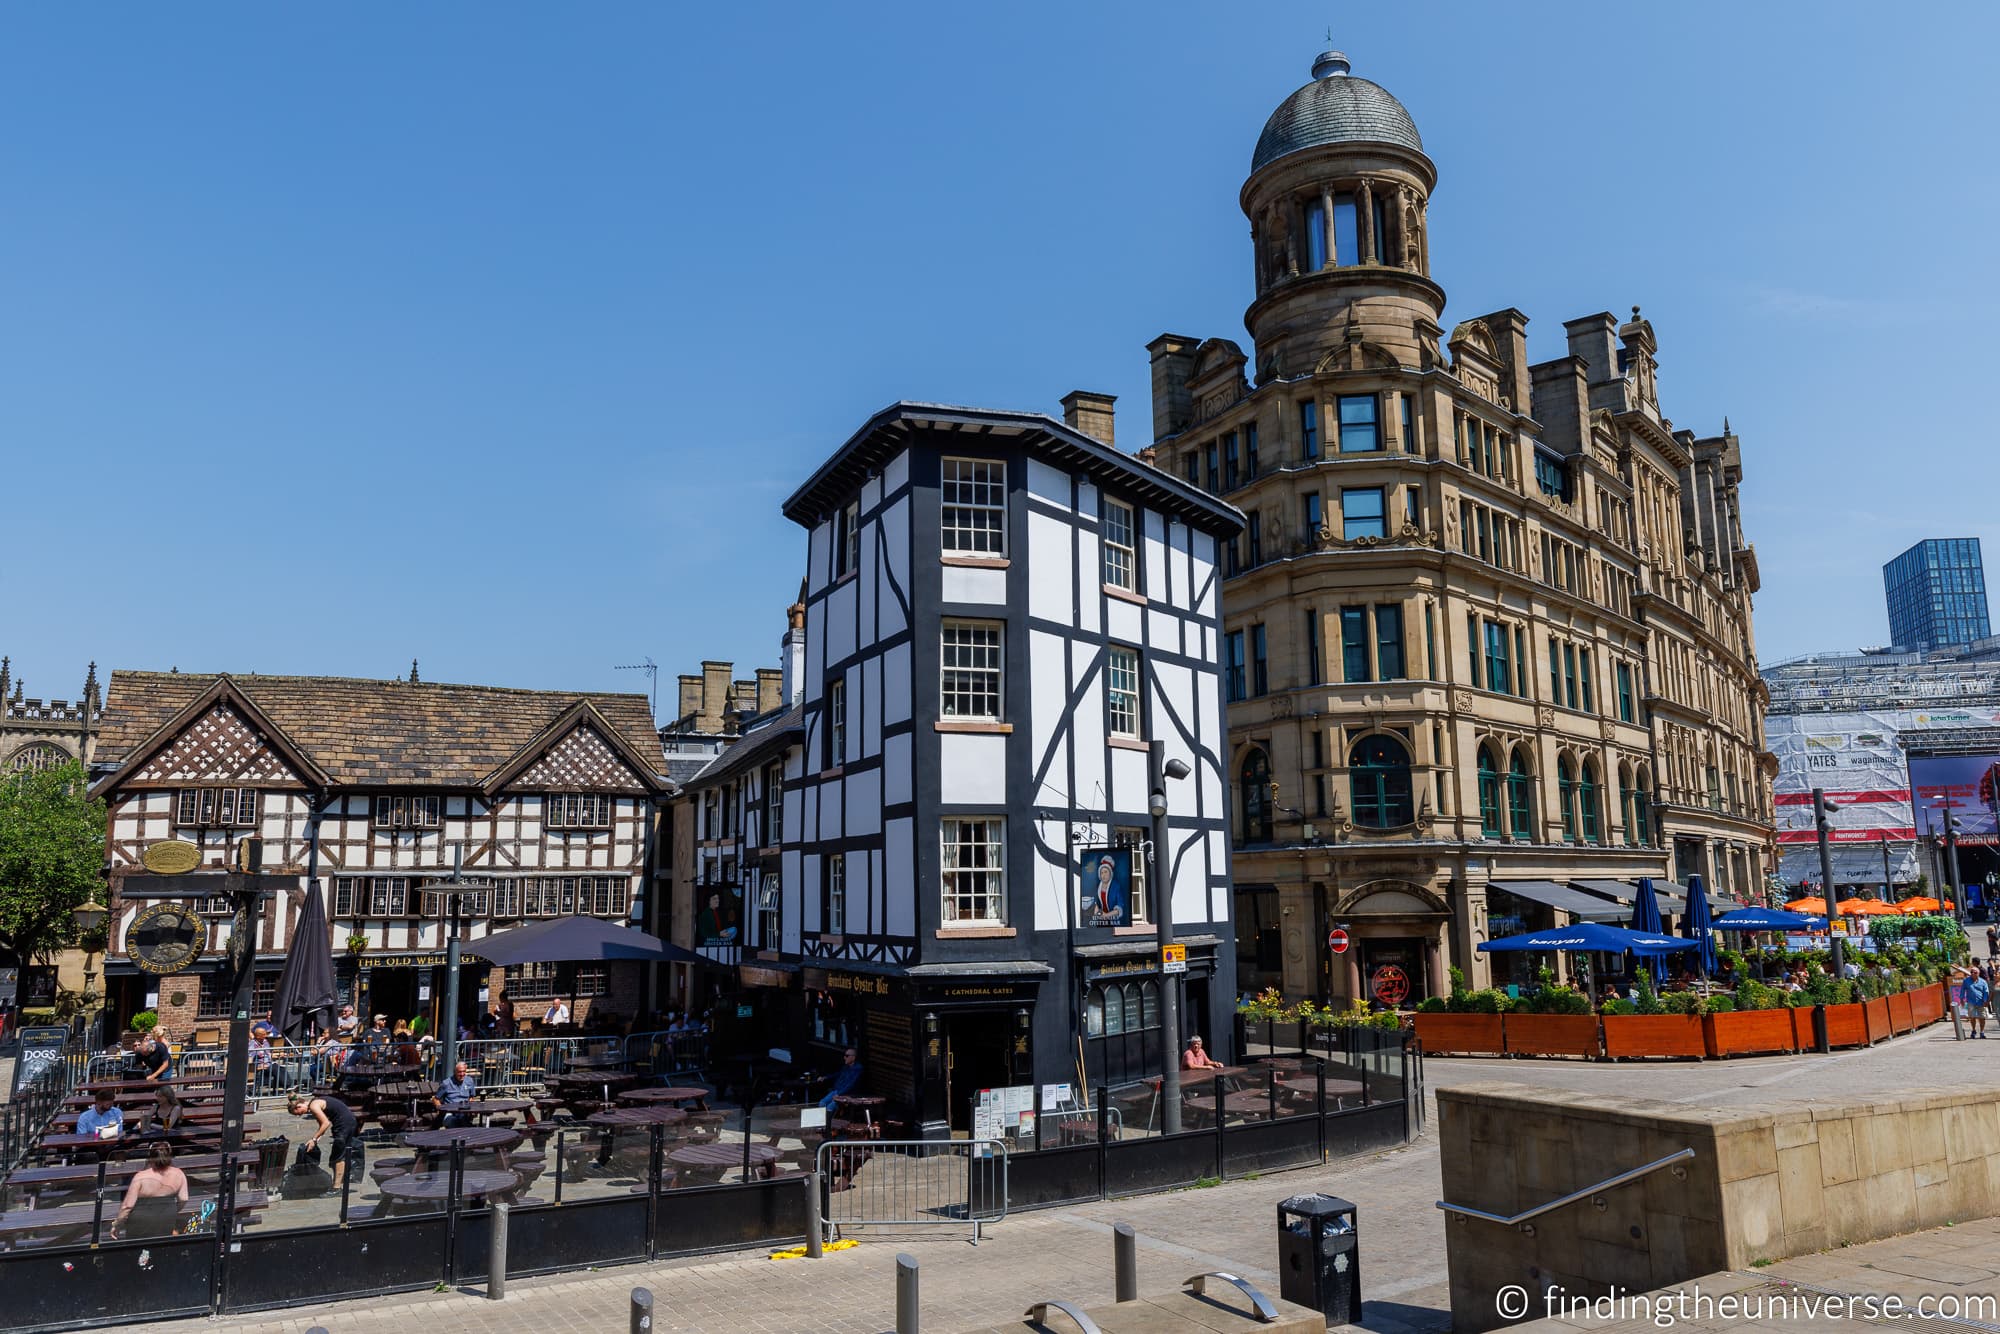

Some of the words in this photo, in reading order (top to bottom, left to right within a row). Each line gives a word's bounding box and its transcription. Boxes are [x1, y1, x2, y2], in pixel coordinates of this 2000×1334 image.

[1807, 755, 1837, 768] YATES
[1850, 756, 1898, 766] wagamama
[155, 904, 181, 913] THE
[1528, 938, 1585, 946] banyan
[127, 939, 139, 960] OLD
[140, 937, 204, 974] WELLINGTON
[358, 958, 381, 967] THE
[386, 957, 411, 966] OLD
[853, 976, 873, 994] Oyster
[876, 976, 889, 994] Bar
[951, 988, 991, 996] CATHEDRAL
[23, 1050, 57, 1062] DOGS
